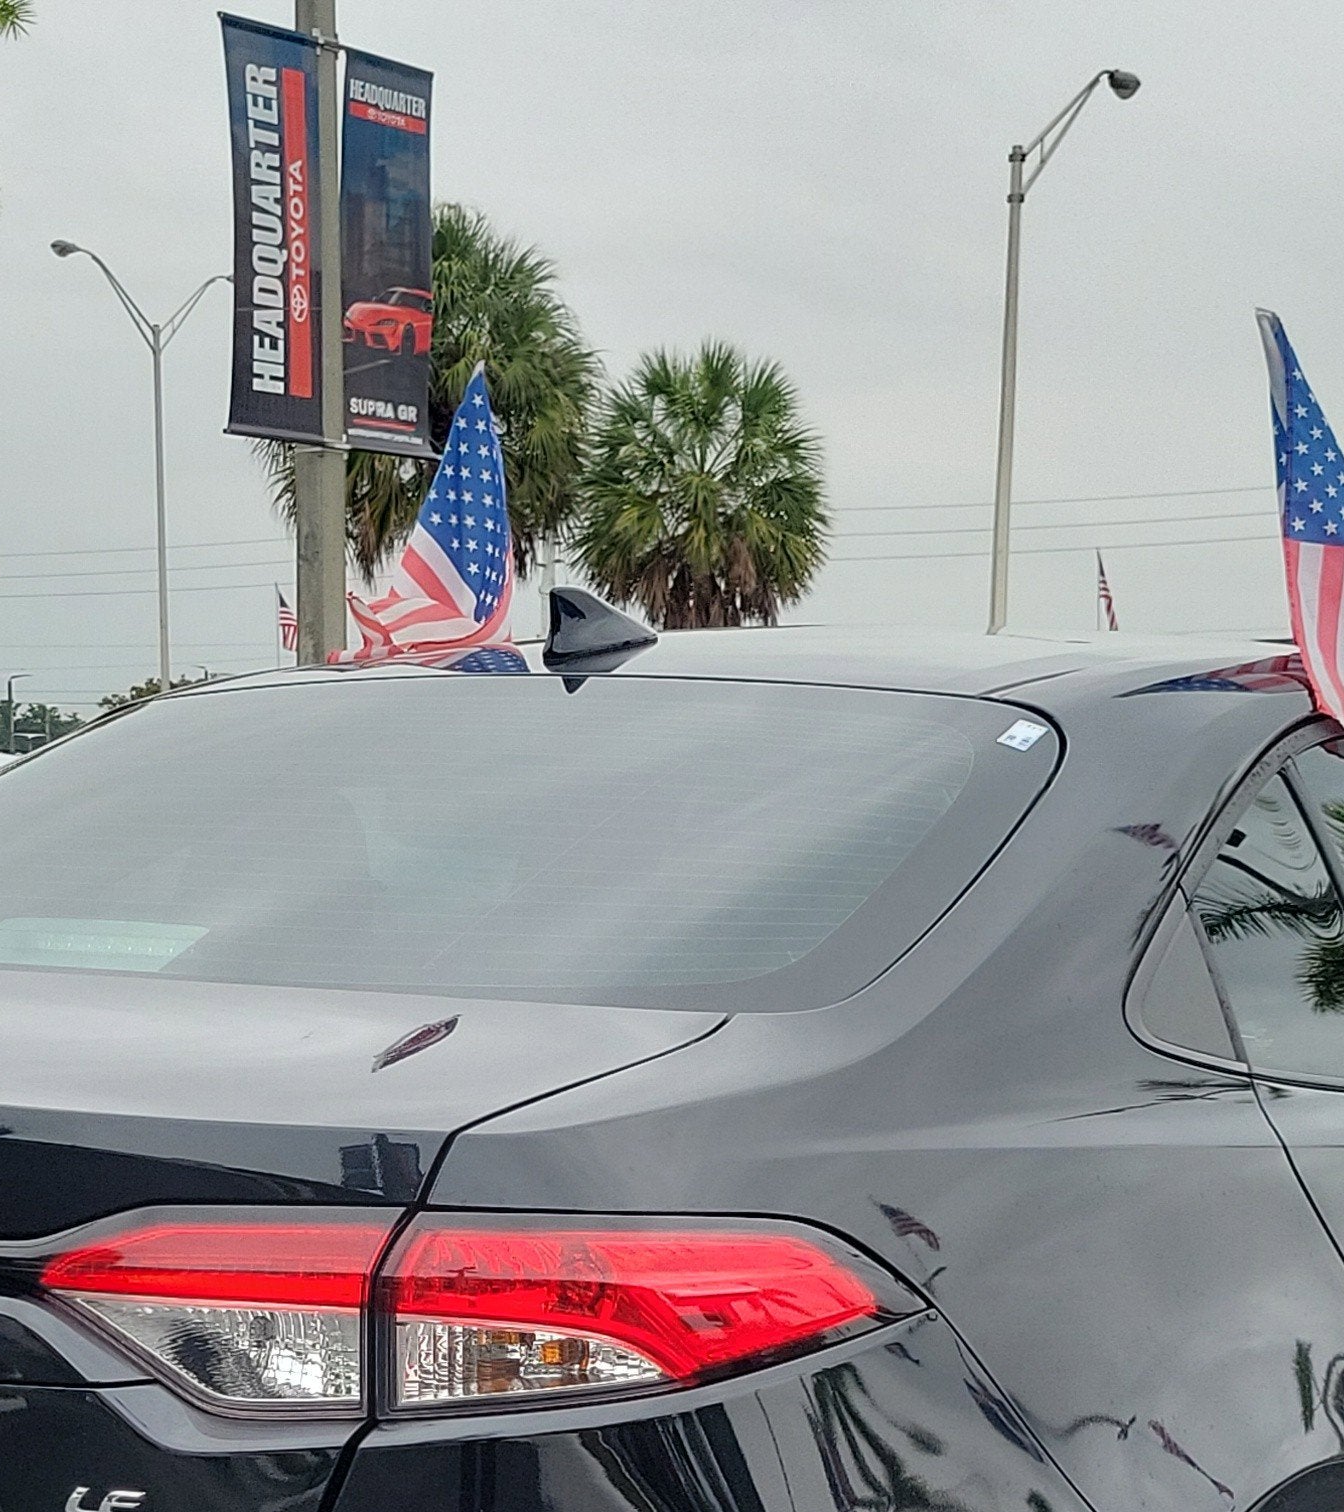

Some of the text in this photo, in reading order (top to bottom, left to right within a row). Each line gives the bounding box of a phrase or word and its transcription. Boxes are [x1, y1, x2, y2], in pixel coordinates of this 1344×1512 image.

[349, 78, 426, 119] HEADQUARTER
[245, 63, 288, 395] HEADQUARTER
[289, 160, 306, 281] TOYOTA
[349, 397, 417, 422] SUPRA GR
